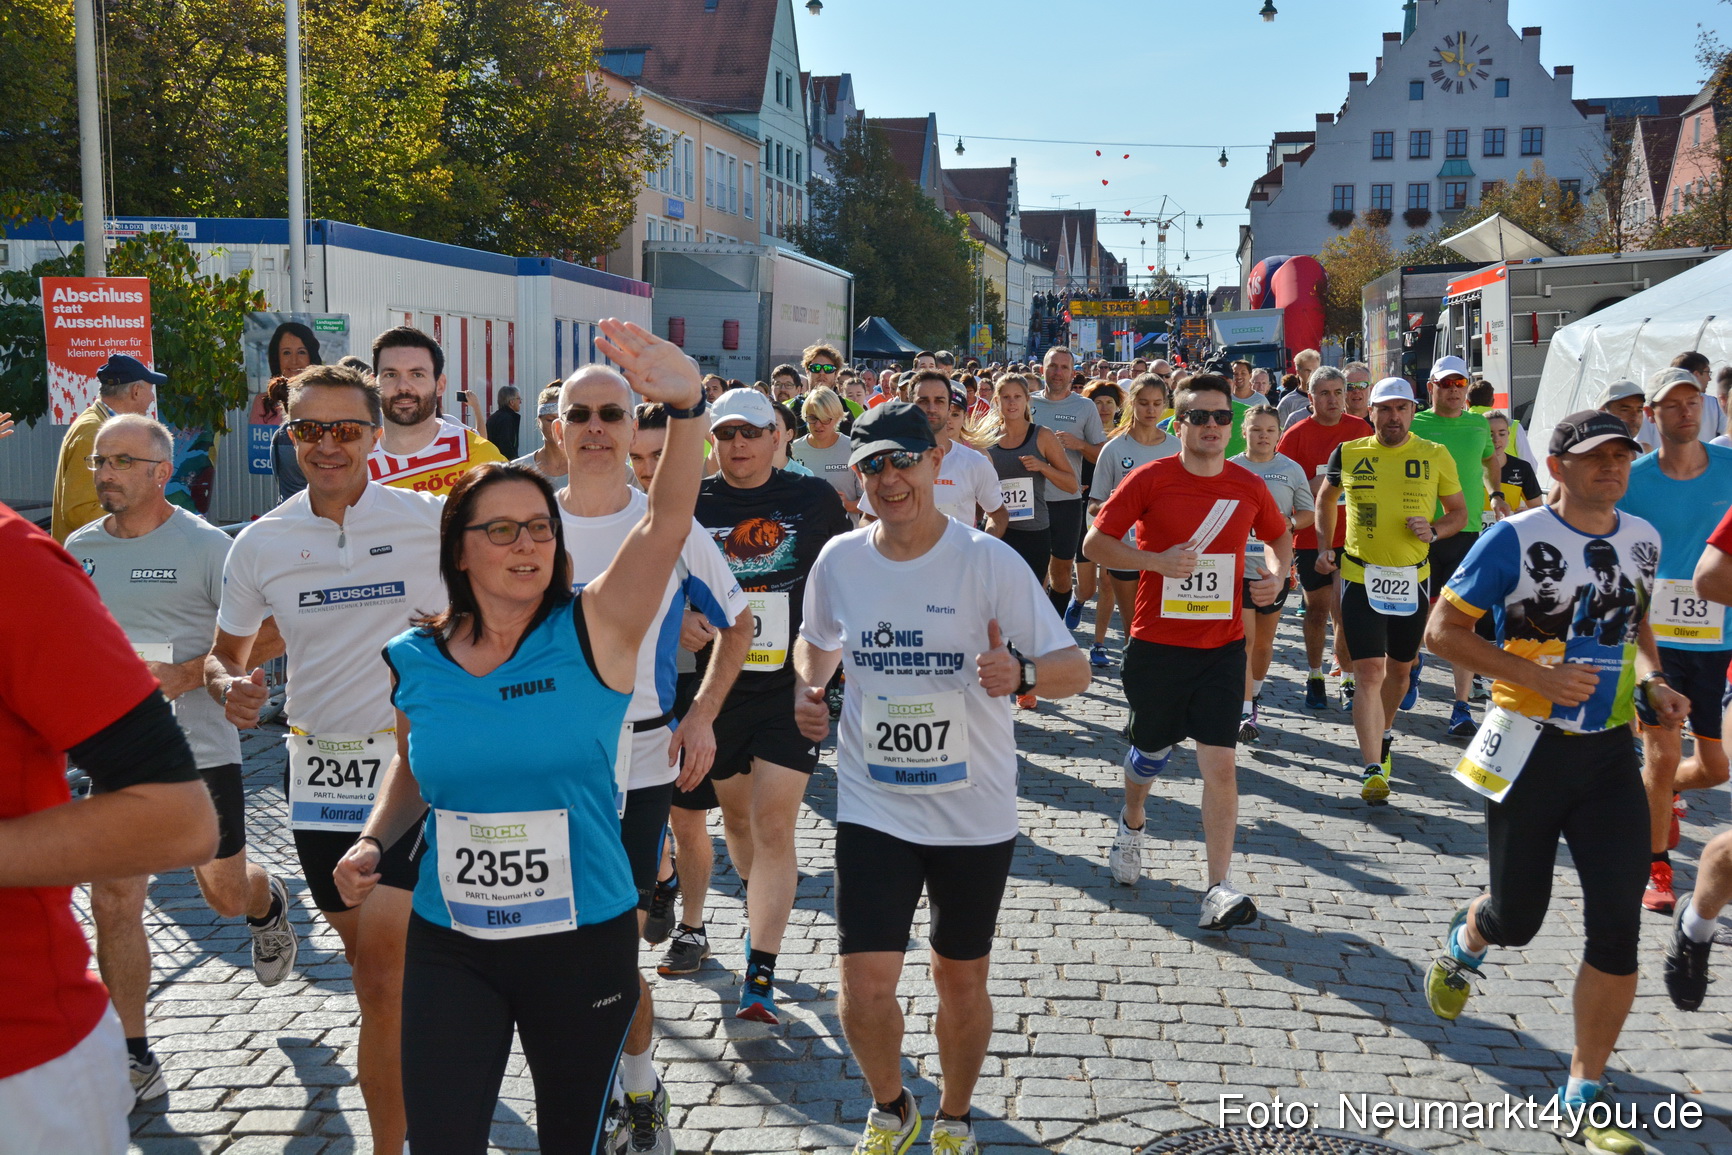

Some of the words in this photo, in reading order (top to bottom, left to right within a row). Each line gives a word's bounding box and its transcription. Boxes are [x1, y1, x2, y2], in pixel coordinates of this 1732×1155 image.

[52, 287, 143, 303] Abschluss
[53, 304, 83, 313] statt
[1101, 304, 1137, 312] START
[54, 315, 145, 328] Ausschluss!
[1232, 326, 1263, 334] BOCK
[71, 338, 96, 347] Mehr
[98, 338, 128, 347] Lehrer
[129, 337, 142, 347] für
[67, 349, 105, 357] kleinere
[131, 569, 177, 580] BOCK
[1180, 572, 1218, 592] 313
[1371, 578, 1410, 595] 2022
[329, 584, 401, 601] BÜSCHEL
[298, 602, 359, 614] FEINSCHNEIDTECHNIK
[364, 598, 406, 607] WERKZEUGBAU
[926, 605, 955, 614] Martin
[1187, 601, 1209, 612] Ömer
[1383, 602, 1397, 610] Erik
[1670, 597, 1708, 617] 133
[1674, 628, 1699, 636] Oliver
[852, 651, 965, 671] Engineering
[499, 678, 556, 701] THULE
[888, 703, 935, 714] BOCK
[876, 720, 950, 752] 2607
[1480, 728, 1502, 757] 99
[317, 739, 364, 751] BOCK
[884, 755, 905, 763] PARTL
[307, 756, 381, 788] 2347
[895, 770, 937, 783] Martin
[313, 791, 335, 799] PARTL
[321, 806, 364, 821] Konrad
[470, 824, 527, 839] BOCK
[456, 847, 549, 887] 2355
[465, 891, 489, 900] PARTL
[492, 891, 532, 900] Neumarkt
[487, 909, 522, 925] Elke
